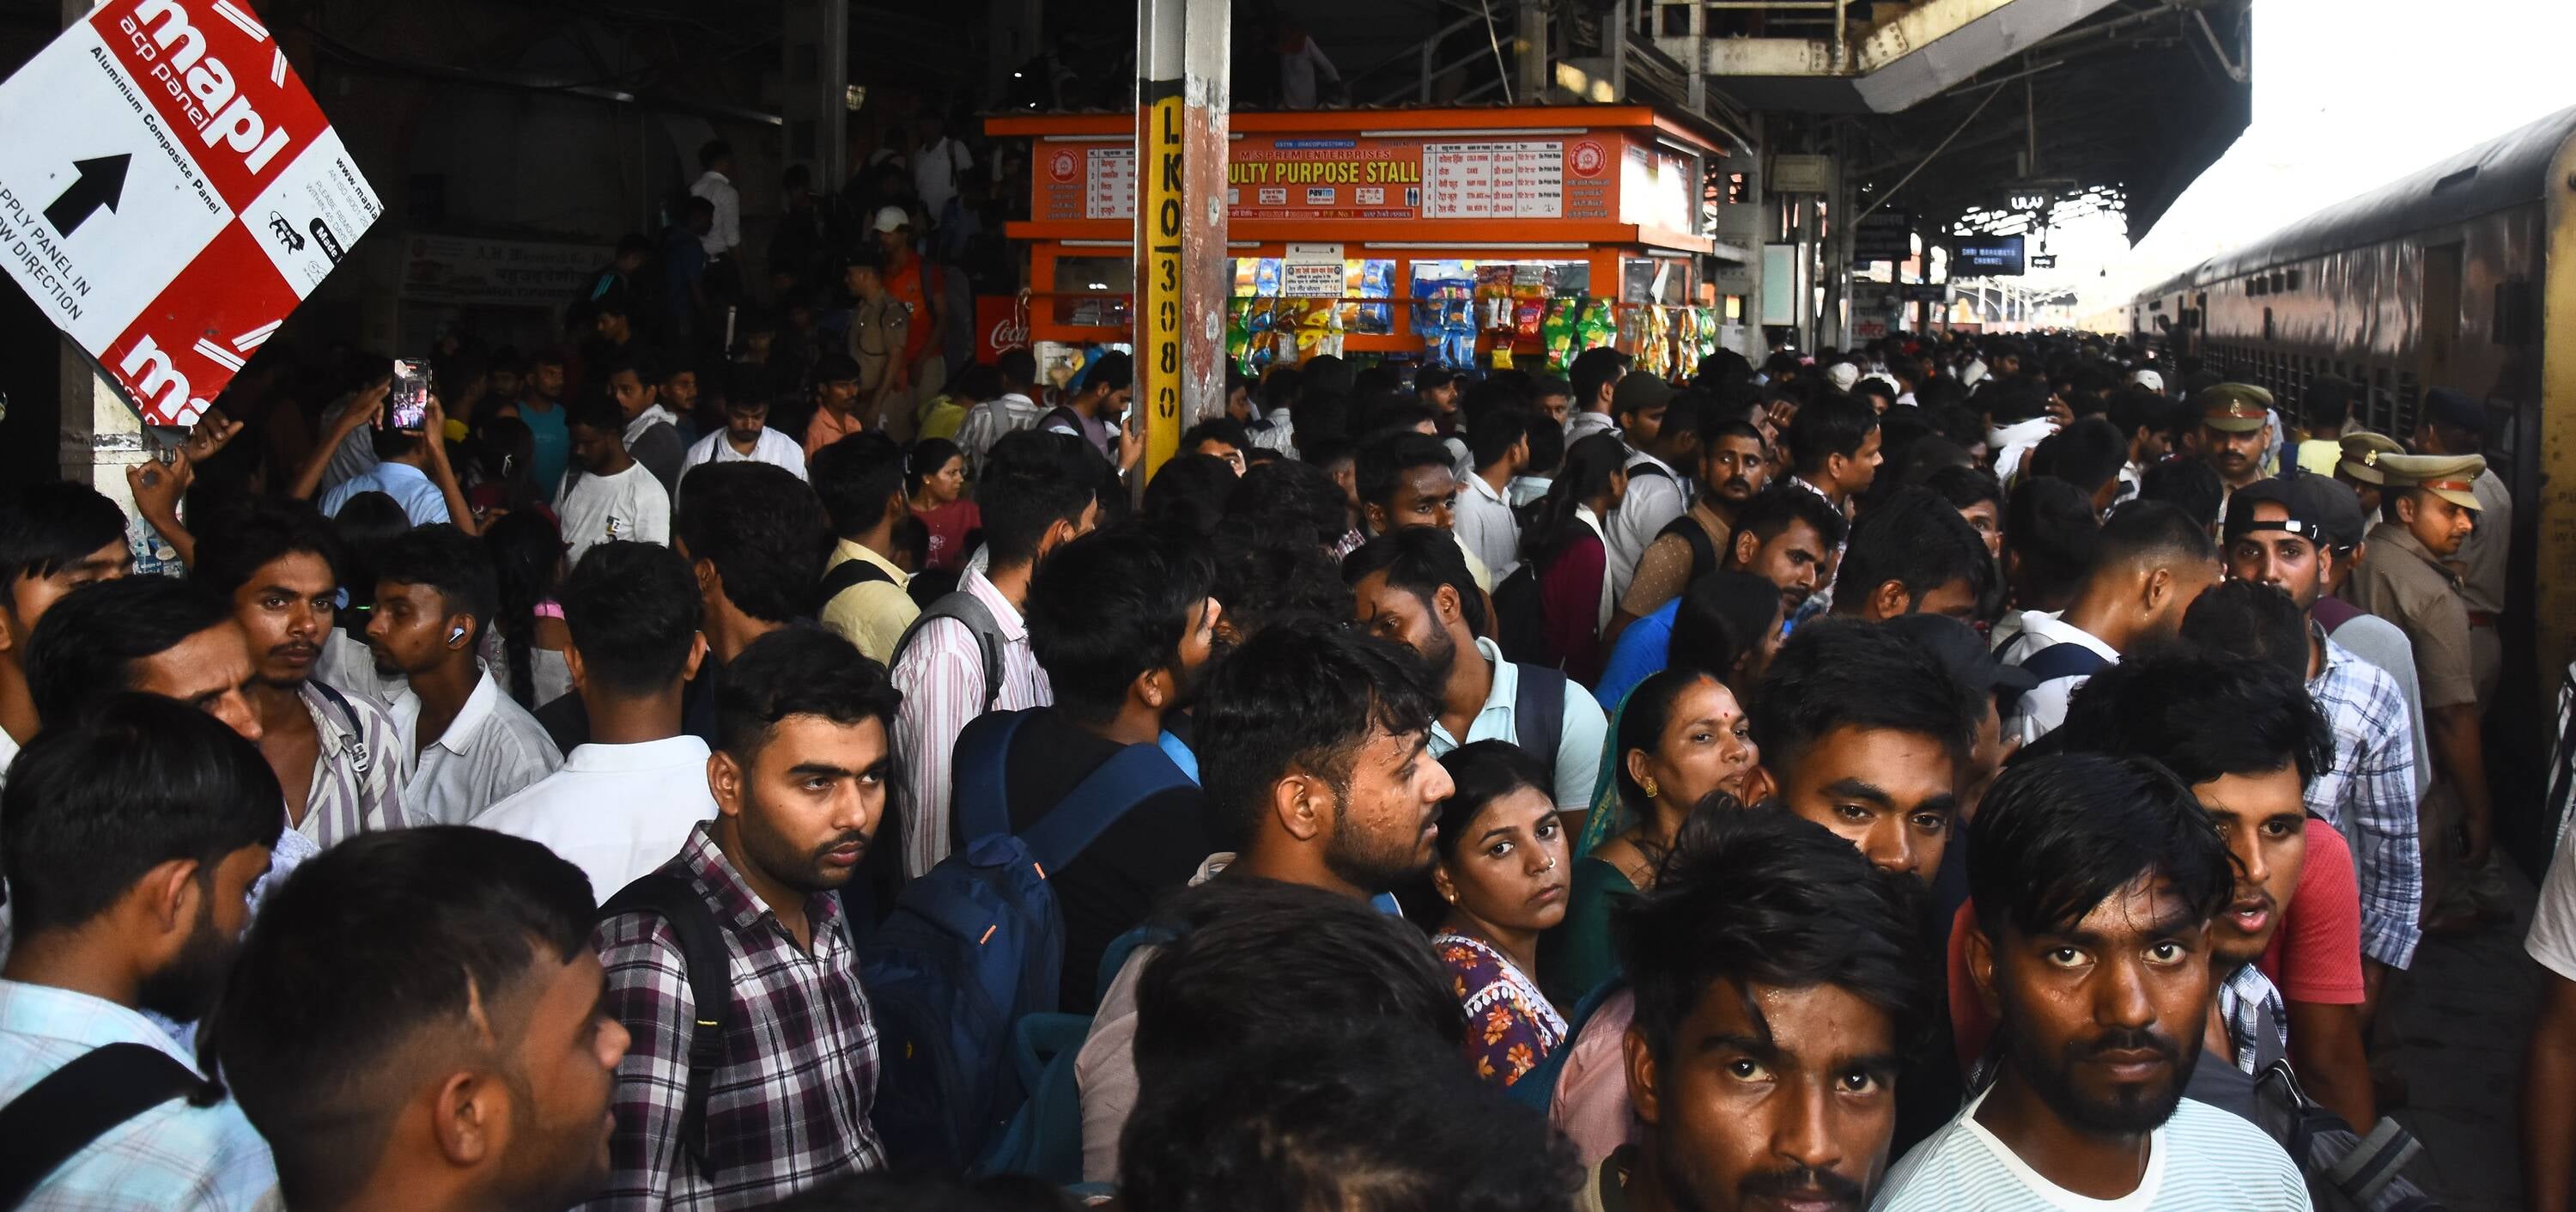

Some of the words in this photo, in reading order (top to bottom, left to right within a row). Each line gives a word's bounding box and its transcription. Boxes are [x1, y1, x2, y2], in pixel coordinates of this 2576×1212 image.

[119, 15, 156, 63] acp
[150, 64, 211, 133] panel
[90, 46, 144, 116] Aluminium
[143, 113, 193, 181] Composite
[192, 178, 222, 216] Panel
[1267, 150, 1302, 160] PREM
[1305, 150, 1391, 160] ENTERPRISES
[336, 157, 378, 221] www.mapla
[1228, 162, 1269, 184] ULTY
[1275, 161, 1360, 184] PURPOSE
[1366, 161, 1420, 184] STALL
[0, 181, 35, 228] PPLY
[30, 227, 74, 280] PANEL
[72, 275, 92, 298] IN
[314, 180, 337, 210] PLEASE
[336, 211, 358, 241] REMOVE
[316, 226, 338, 258] Made
[13, 241, 83, 321] DIRECTION
